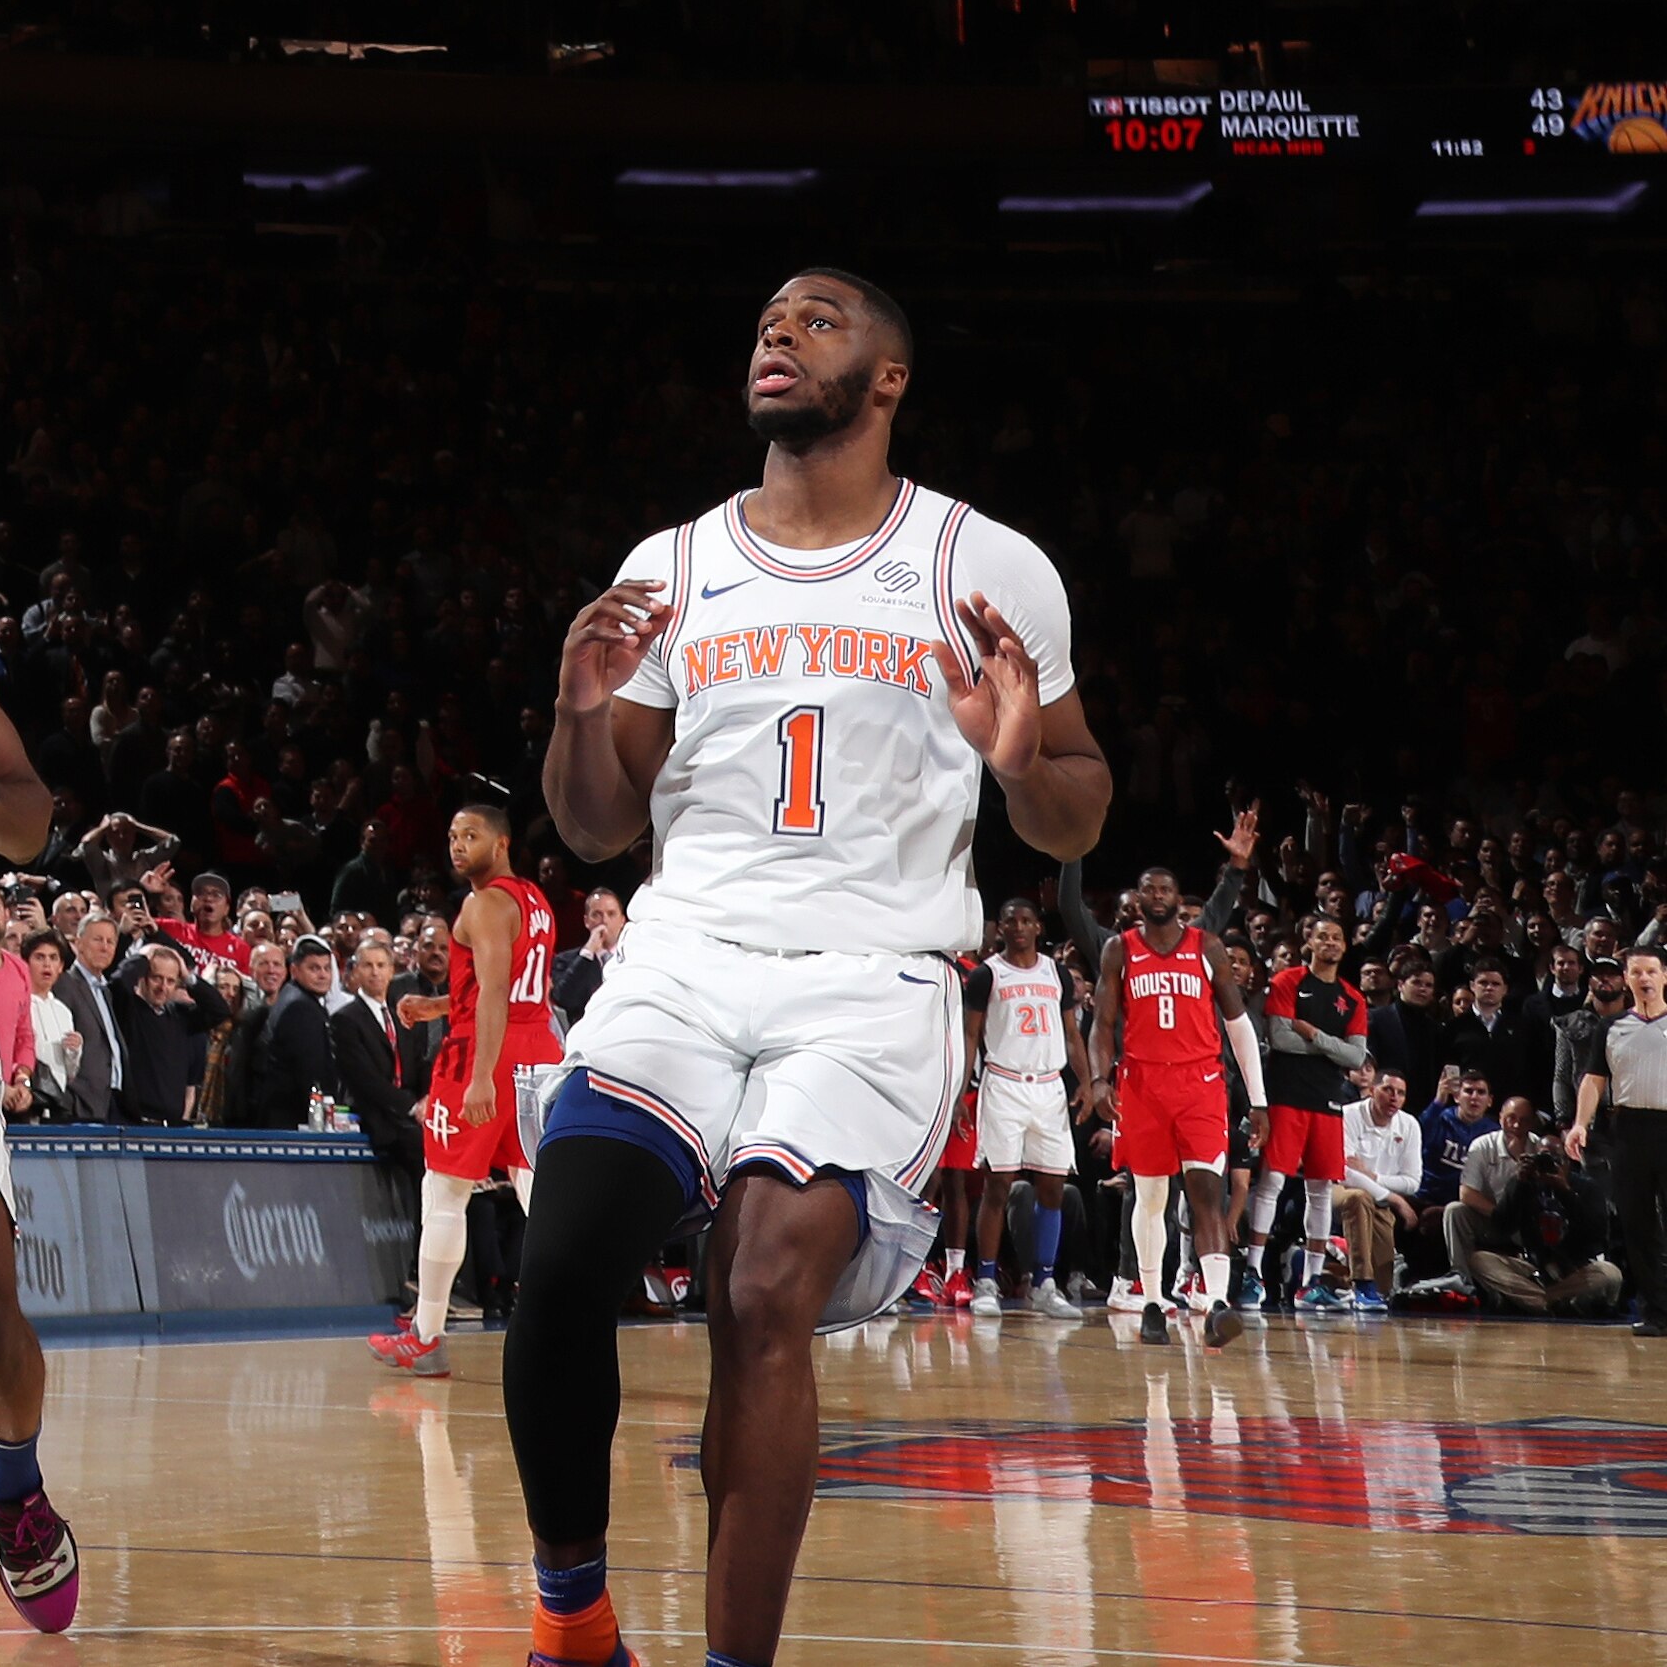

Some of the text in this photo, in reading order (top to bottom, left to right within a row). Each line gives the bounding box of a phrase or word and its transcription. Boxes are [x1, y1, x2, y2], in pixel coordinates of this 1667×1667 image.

[1124, 96, 1212, 115] TISSOT
[1220, 90, 1310, 112] DEPAUL
[1530, 88, 1563, 111] 43
[1105, 118, 1203, 152] 10:07
[1221, 115, 1360, 140] MARQUETTE
[1233, 140, 1281, 155] NCAA
[861, 595, 926, 610] SQUARESPACE
[682, 622, 933, 699] NEW YORK
[772, 705, 825, 836] 1
[999, 983, 1058, 1001] NEW YORK
[1130, 971, 1201, 1000] HOUSTON
[1017, 1004, 1050, 1036] 21
[1157, 995, 1176, 1030] 8
[223, 1179, 323, 1282] Cuervo
